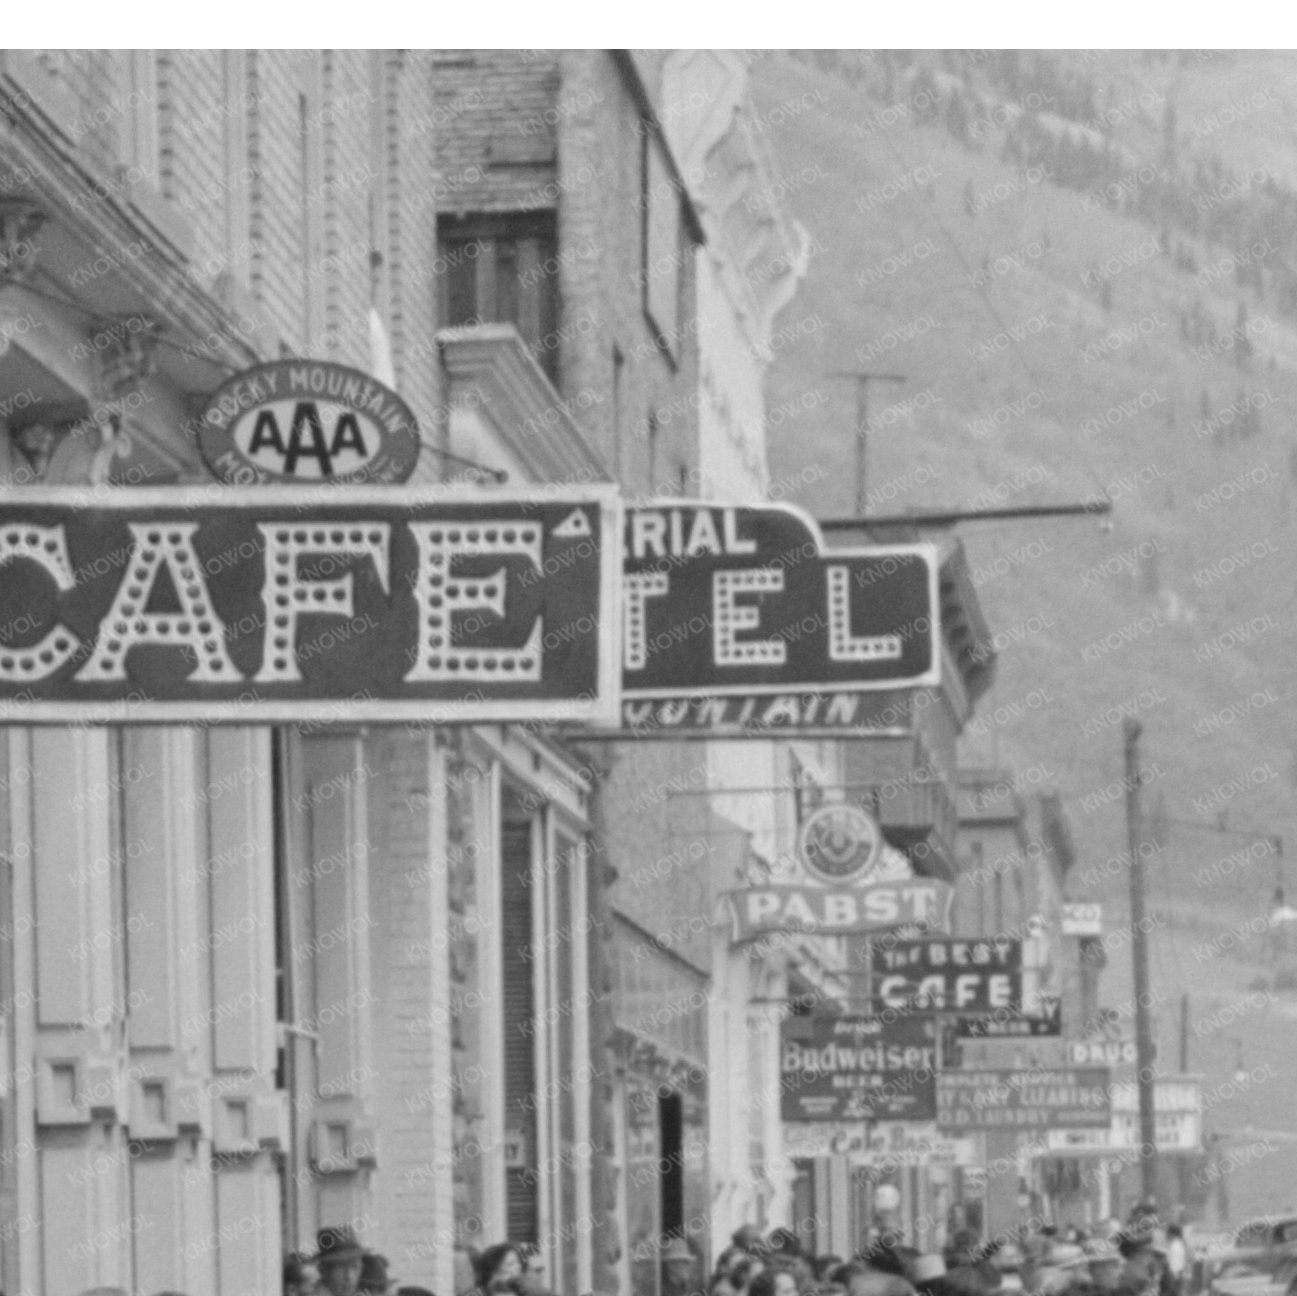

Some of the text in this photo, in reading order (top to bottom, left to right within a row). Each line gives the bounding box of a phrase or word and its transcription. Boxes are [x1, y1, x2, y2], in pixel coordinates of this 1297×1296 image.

[206, 367, 405, 434] ROCKY MOUNTAIN
[248, 401, 369, 475] AAA
[747, 886, 938, 926] PABST
[928, 942, 1011, 966] BEST
[879, 973, 1012, 1009] CAFE
[782, 1040, 932, 1072] Budweiser
